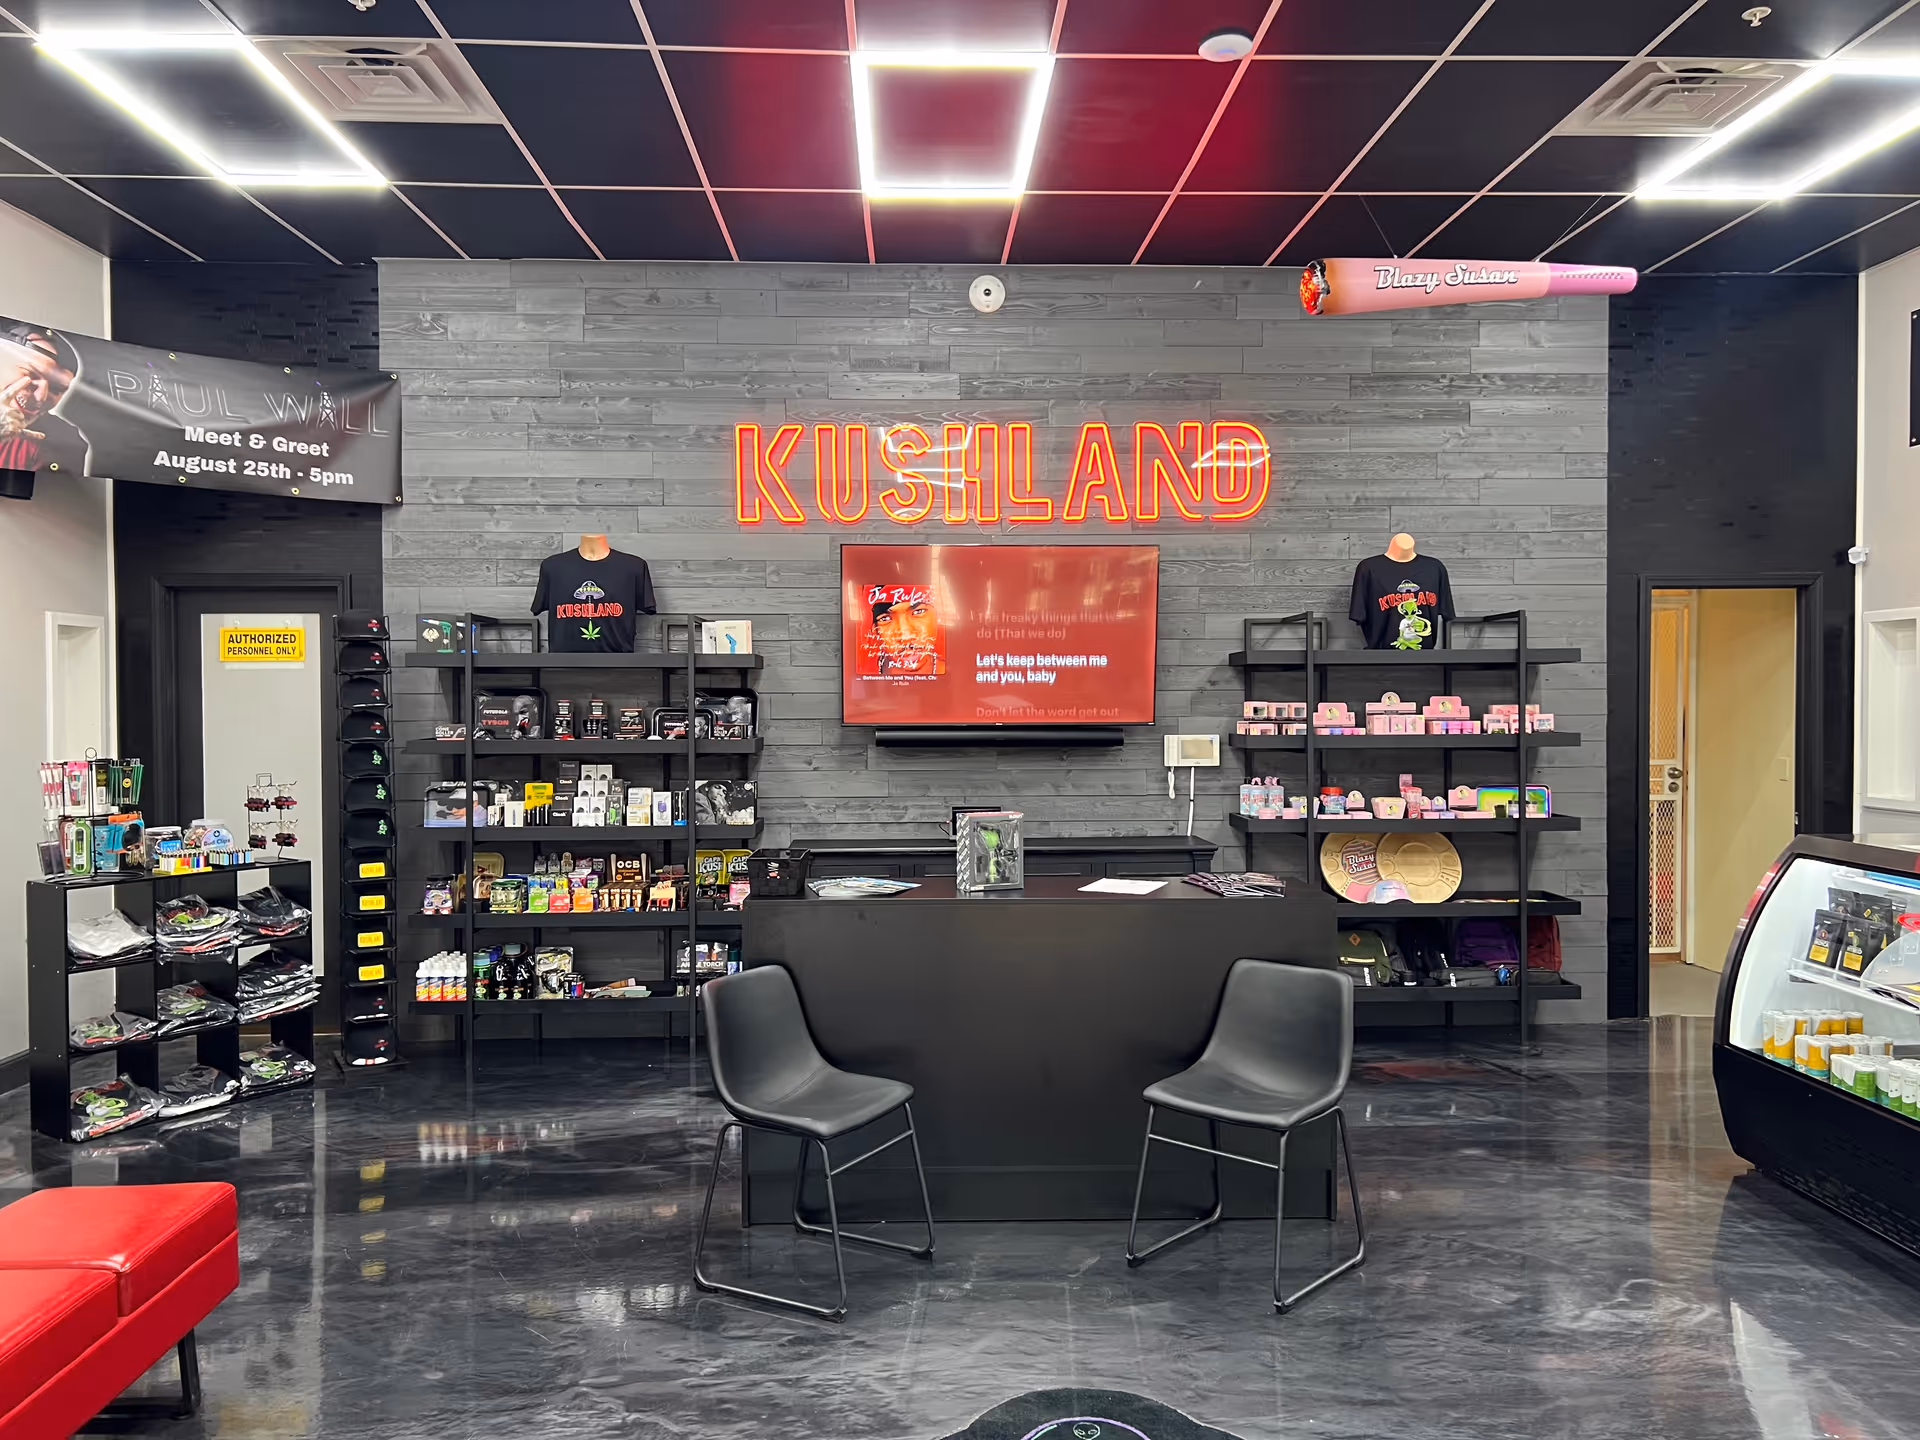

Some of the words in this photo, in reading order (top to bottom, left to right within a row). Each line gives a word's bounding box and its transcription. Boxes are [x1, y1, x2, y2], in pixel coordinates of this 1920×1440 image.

[1373, 265, 1440, 293] Blazy
[1445, 263, 1518, 286] Susan
[107, 368, 252, 424] PAUL
[264, 390, 390, 437] WALL
[184, 425, 242, 449] Meet
[248, 433, 267, 449] &
[272, 435, 330, 457] Greet
[154, 450, 236, 474] August
[243, 459, 291, 480] 25th
[309, 466, 354, 486] 5pm
[735, 422, 1271, 524] KUSHLAND
[868, 587, 887, 604] Ja
[890, 587, 924, 606] Rule
[556, 602, 623, 619] KUSHLAND
[1002, 611, 1038, 624] freaky
[1041, 611, 1075, 624] things
[227, 634, 297, 644] AUTHORIZED
[976, 628, 991, 639] do
[994, 628, 1025, 640] (That
[1028, 630, 1045, 639] we
[1047, 628, 1066, 640] do)
[227, 646, 273, 656] PERSONNEL
[276, 646, 297, 656] ONLY
[976, 653, 1005, 667] Let's
[1006, 653, 1035, 669] keep
[1036, 653, 1088, 667] between
[1089, 655, 1108, 667] me
[976, 669, 999, 682] and
[1000, 671, 1025, 685] you,
[1027, 669, 1056, 685] baby
[976, 707, 1007, 718] Don't
[1009, 707, 1024, 717] let
[1026, 707, 1044, 717] the
[1047, 707, 1076, 717] word
[1079, 707, 1098, 718] get
[1100, 708, 1119, 717] out
[616, 860, 640, 868] OCB
[728, 861, 748, 872] KUS
[1346, 854, 1375, 864] Blazy
